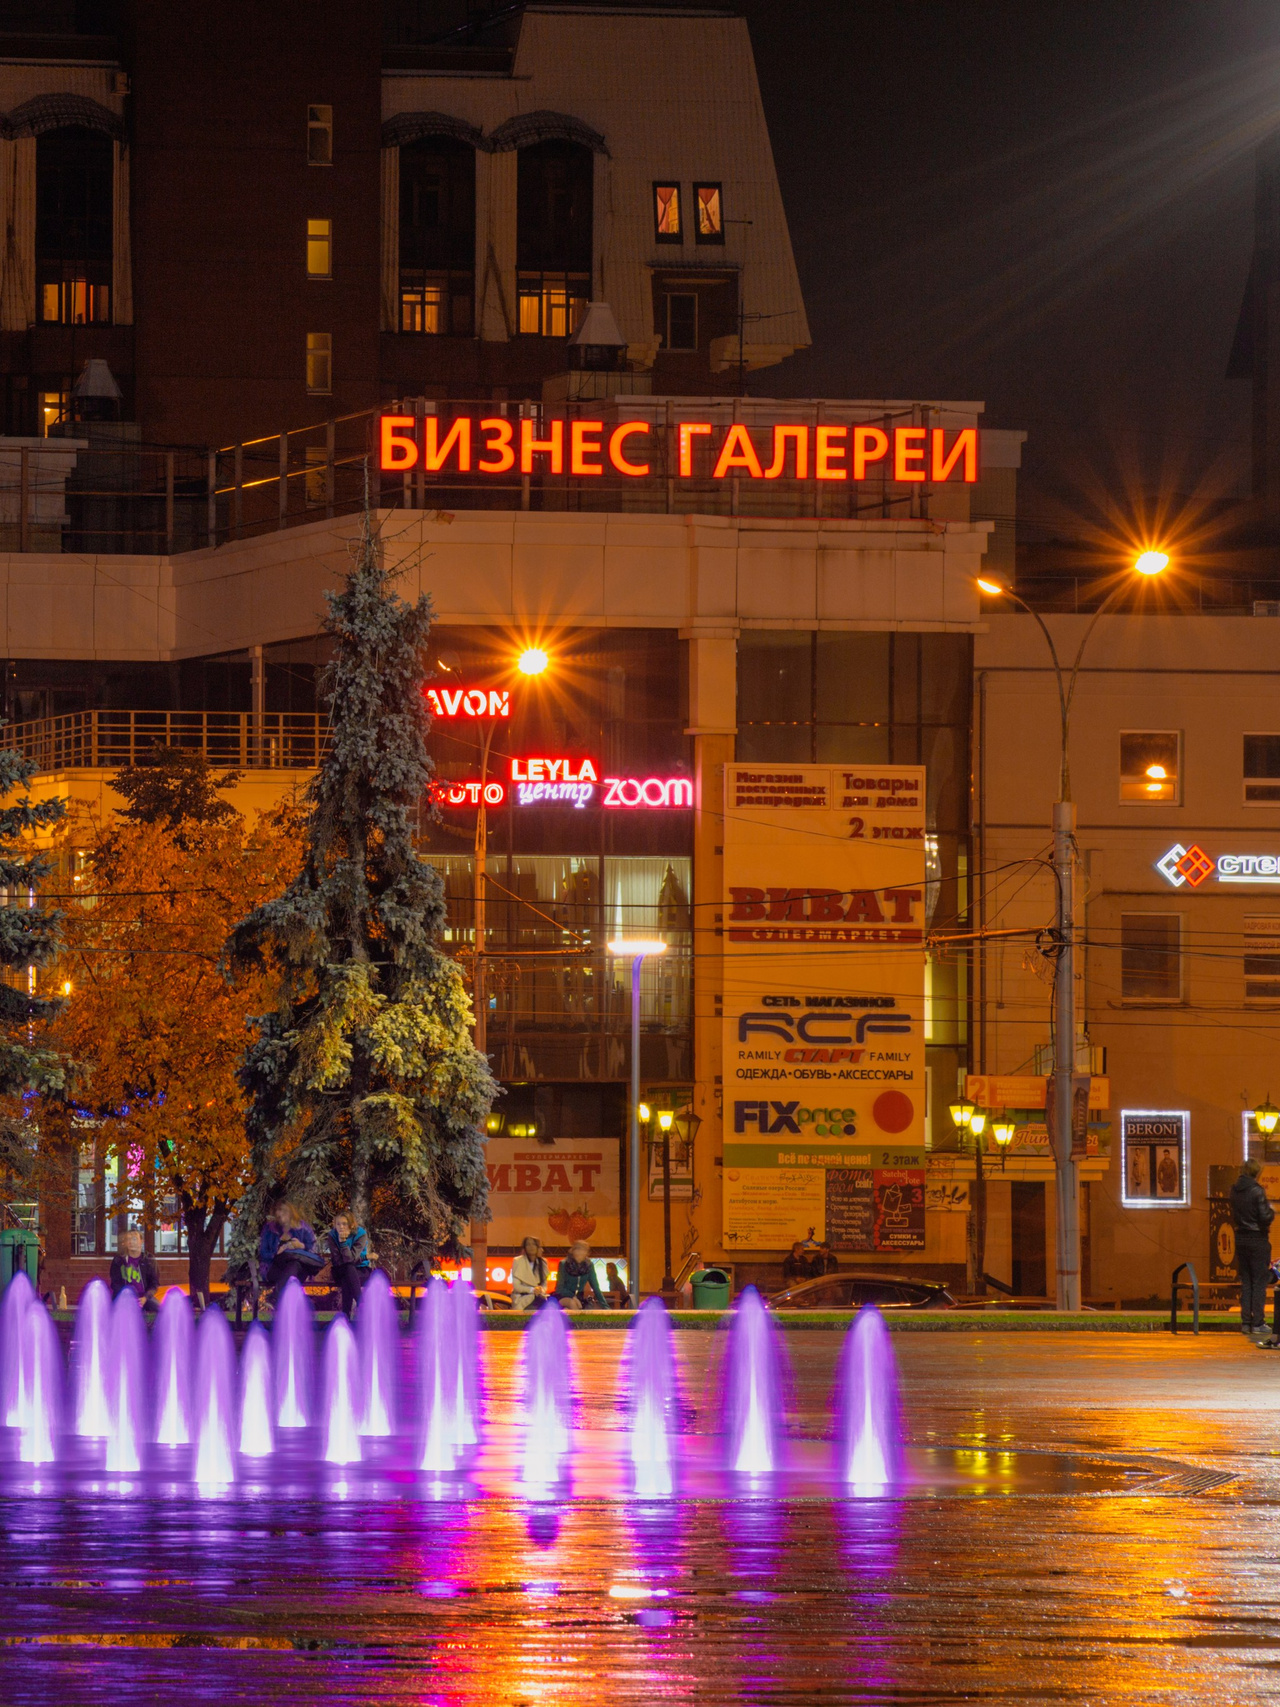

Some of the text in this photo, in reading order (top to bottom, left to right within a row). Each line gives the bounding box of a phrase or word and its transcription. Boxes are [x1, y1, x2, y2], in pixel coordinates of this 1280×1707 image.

[379, 415, 978, 482] БИЗНЕС ГАЛЕРЕИ
[512, 759, 597, 781] LEYLA
[736, 772, 803, 784] Магазин
[843, 773, 919, 796] Товары
[428, 783, 503, 804] ОТО
[518, 782, 592, 808] центр
[736, 786, 826, 795] постоянных
[736, 796, 826, 807] распродаж
[842, 797, 918, 807] для дома
[849, 817, 924, 839] 2 этаж
[728, 887, 922, 923] ВИВАТ
[752, 929, 902, 940] СУПЕРМАРКЕТ
[762, 996, 895, 1008] СЕТЬ МАГАЗИНОВ
[738, 1012, 912, 1044] RCF
[738, 1048, 911, 1063] RAMILY СТАРТ FAMILY
[736, 1069, 913, 1081] ОДЕЖДА ОБУВЬ АКСЕССУАРЫ
[1127, 1124, 1177, 1135] BERONI
[778, 1153, 795, 1164] Всё
[811, 1153, 842, 1166] одной
[844, 1153, 871, 1166] цене!
[882, 1153, 919, 1165] 2 этаж
[912, 1189, 922, 1202] 3
